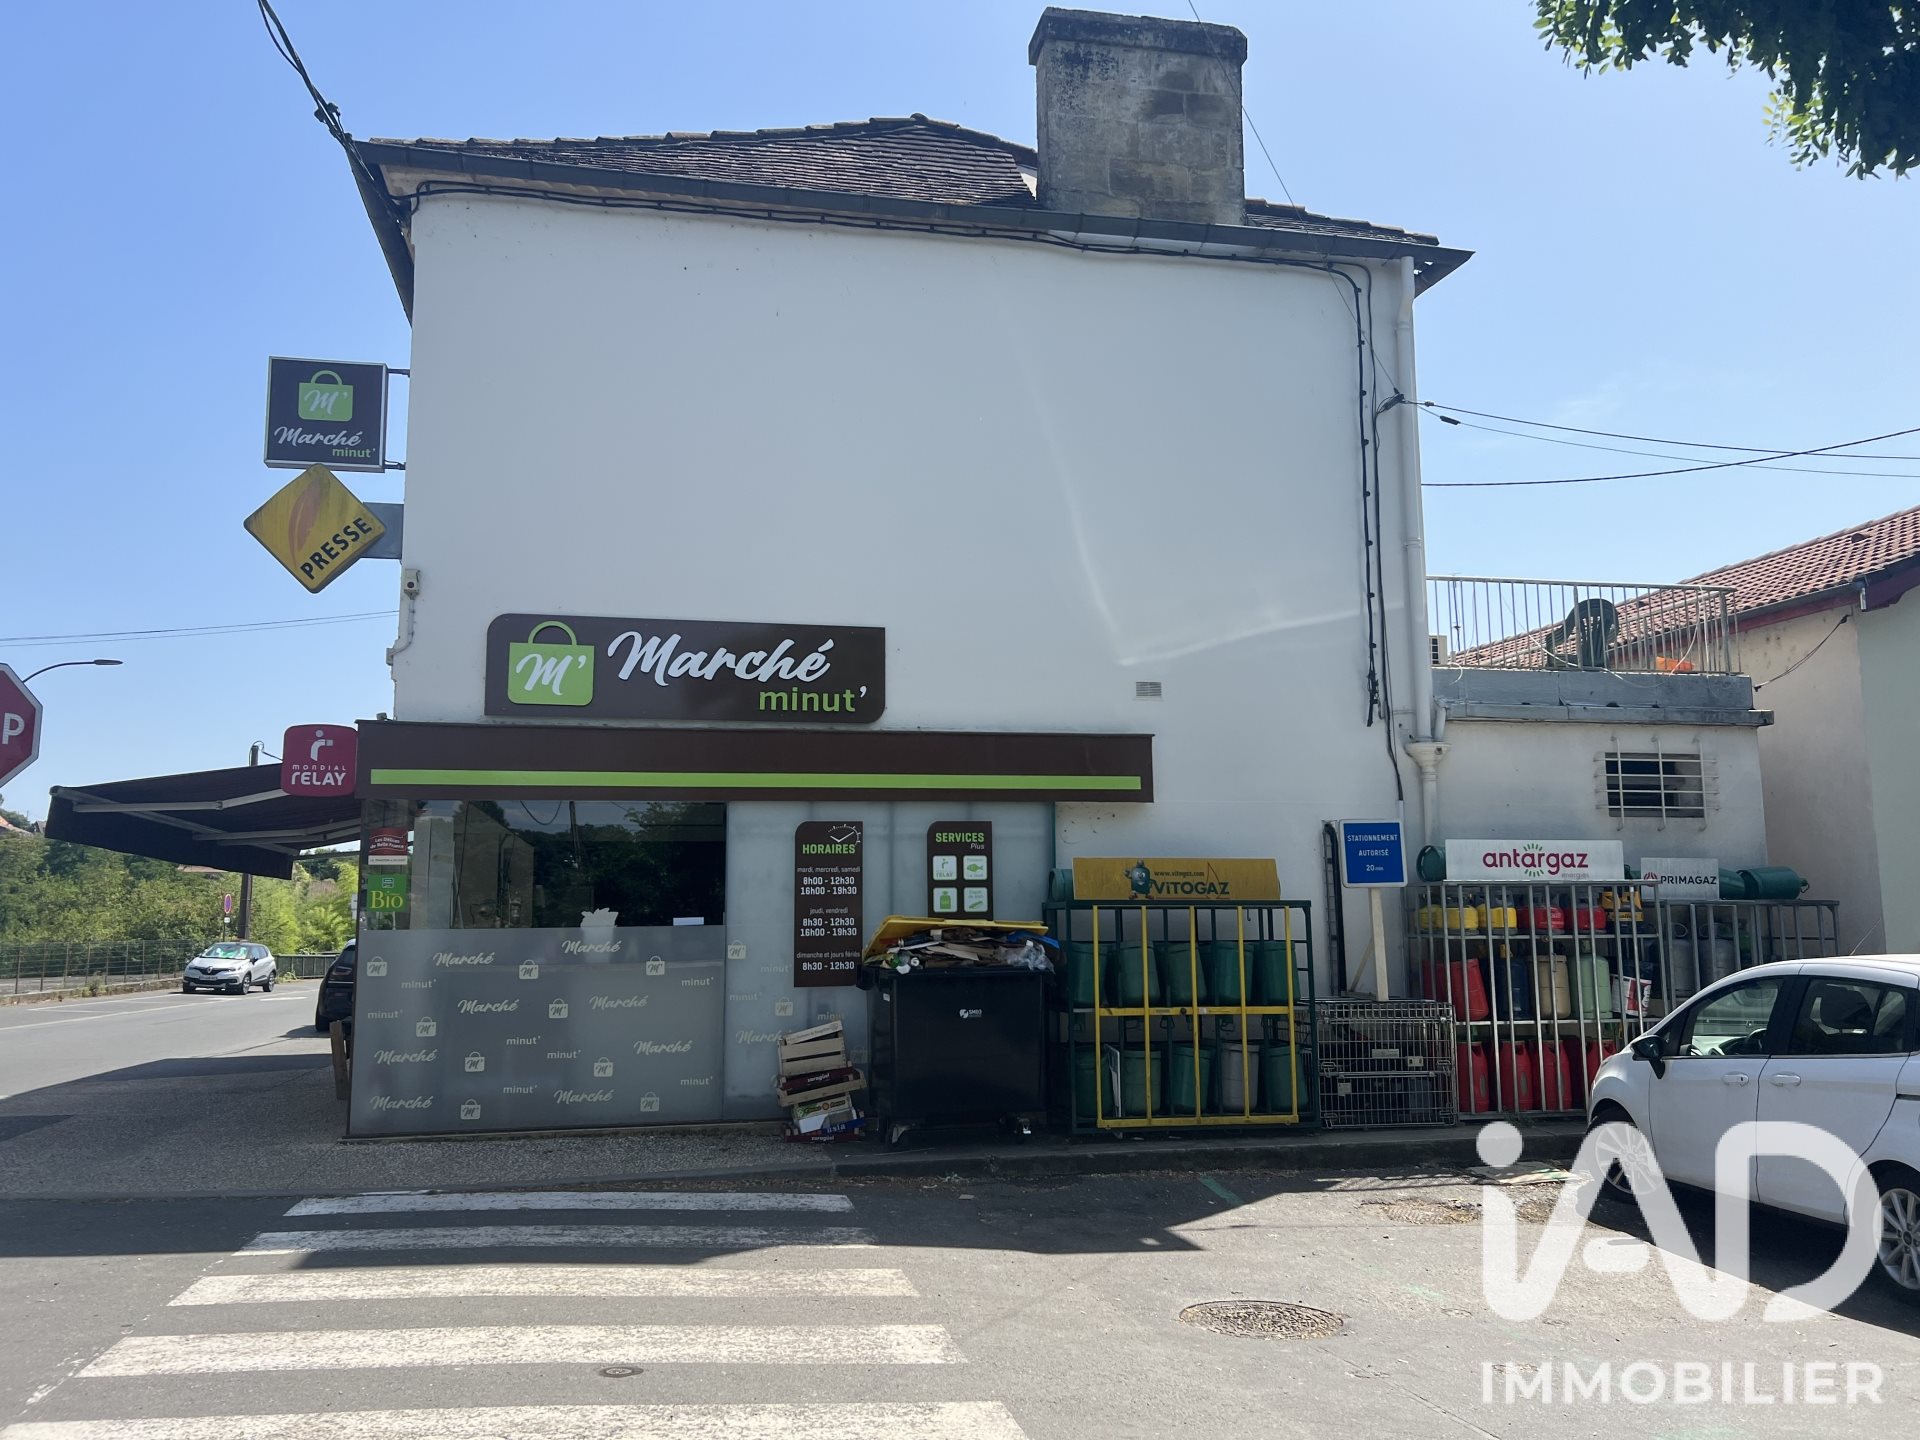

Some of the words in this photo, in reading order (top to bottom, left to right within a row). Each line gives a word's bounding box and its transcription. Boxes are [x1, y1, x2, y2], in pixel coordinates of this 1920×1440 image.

[274, 426, 362, 447] Marché
[332, 447, 376, 458] minut'
[300, 518, 372, 580] PRESSE
[607, 631, 834, 686] Marché
[759, 686, 867, 712] minut'
[935, 832, 985, 842] SERVICES
[1347, 834, 1398, 842] STATIONNEMENT
[802, 844, 856, 854] HORAIRES
[1358, 848, 1389, 857] AUTORISÉ
[1483, 849, 1588, 875] antargaz
[803, 877, 823, 885] 8h00
[830, 876, 855, 885] 12h30
[1660, 875, 1717, 885] PRIMAGAZ
[800, 887, 825, 895] 16h00
[832, 886, 857, 895] 19h30
[370, 890, 403, 909] Bio
[803, 918, 823, 926] 8h30
[830, 917, 855, 926] 12h30
[800, 928, 825, 937] 16h00
[832, 927, 857, 936] 19h30
[561, 940, 622, 955] Marché
[433, 952, 495, 967] Marché
[803, 962, 822, 971] 8h30
[830, 961, 855, 970] 12h30
[457, 999, 520, 1014] Marché
[589, 995, 649, 1010] Marché
[735, 1030, 792, 1044] March
[633, 1040, 693, 1055] Marché
[374, 1049, 438, 1065] Marché
[369, 1096, 433, 1111] Marché
[553, 1089, 615, 1104] Marché
